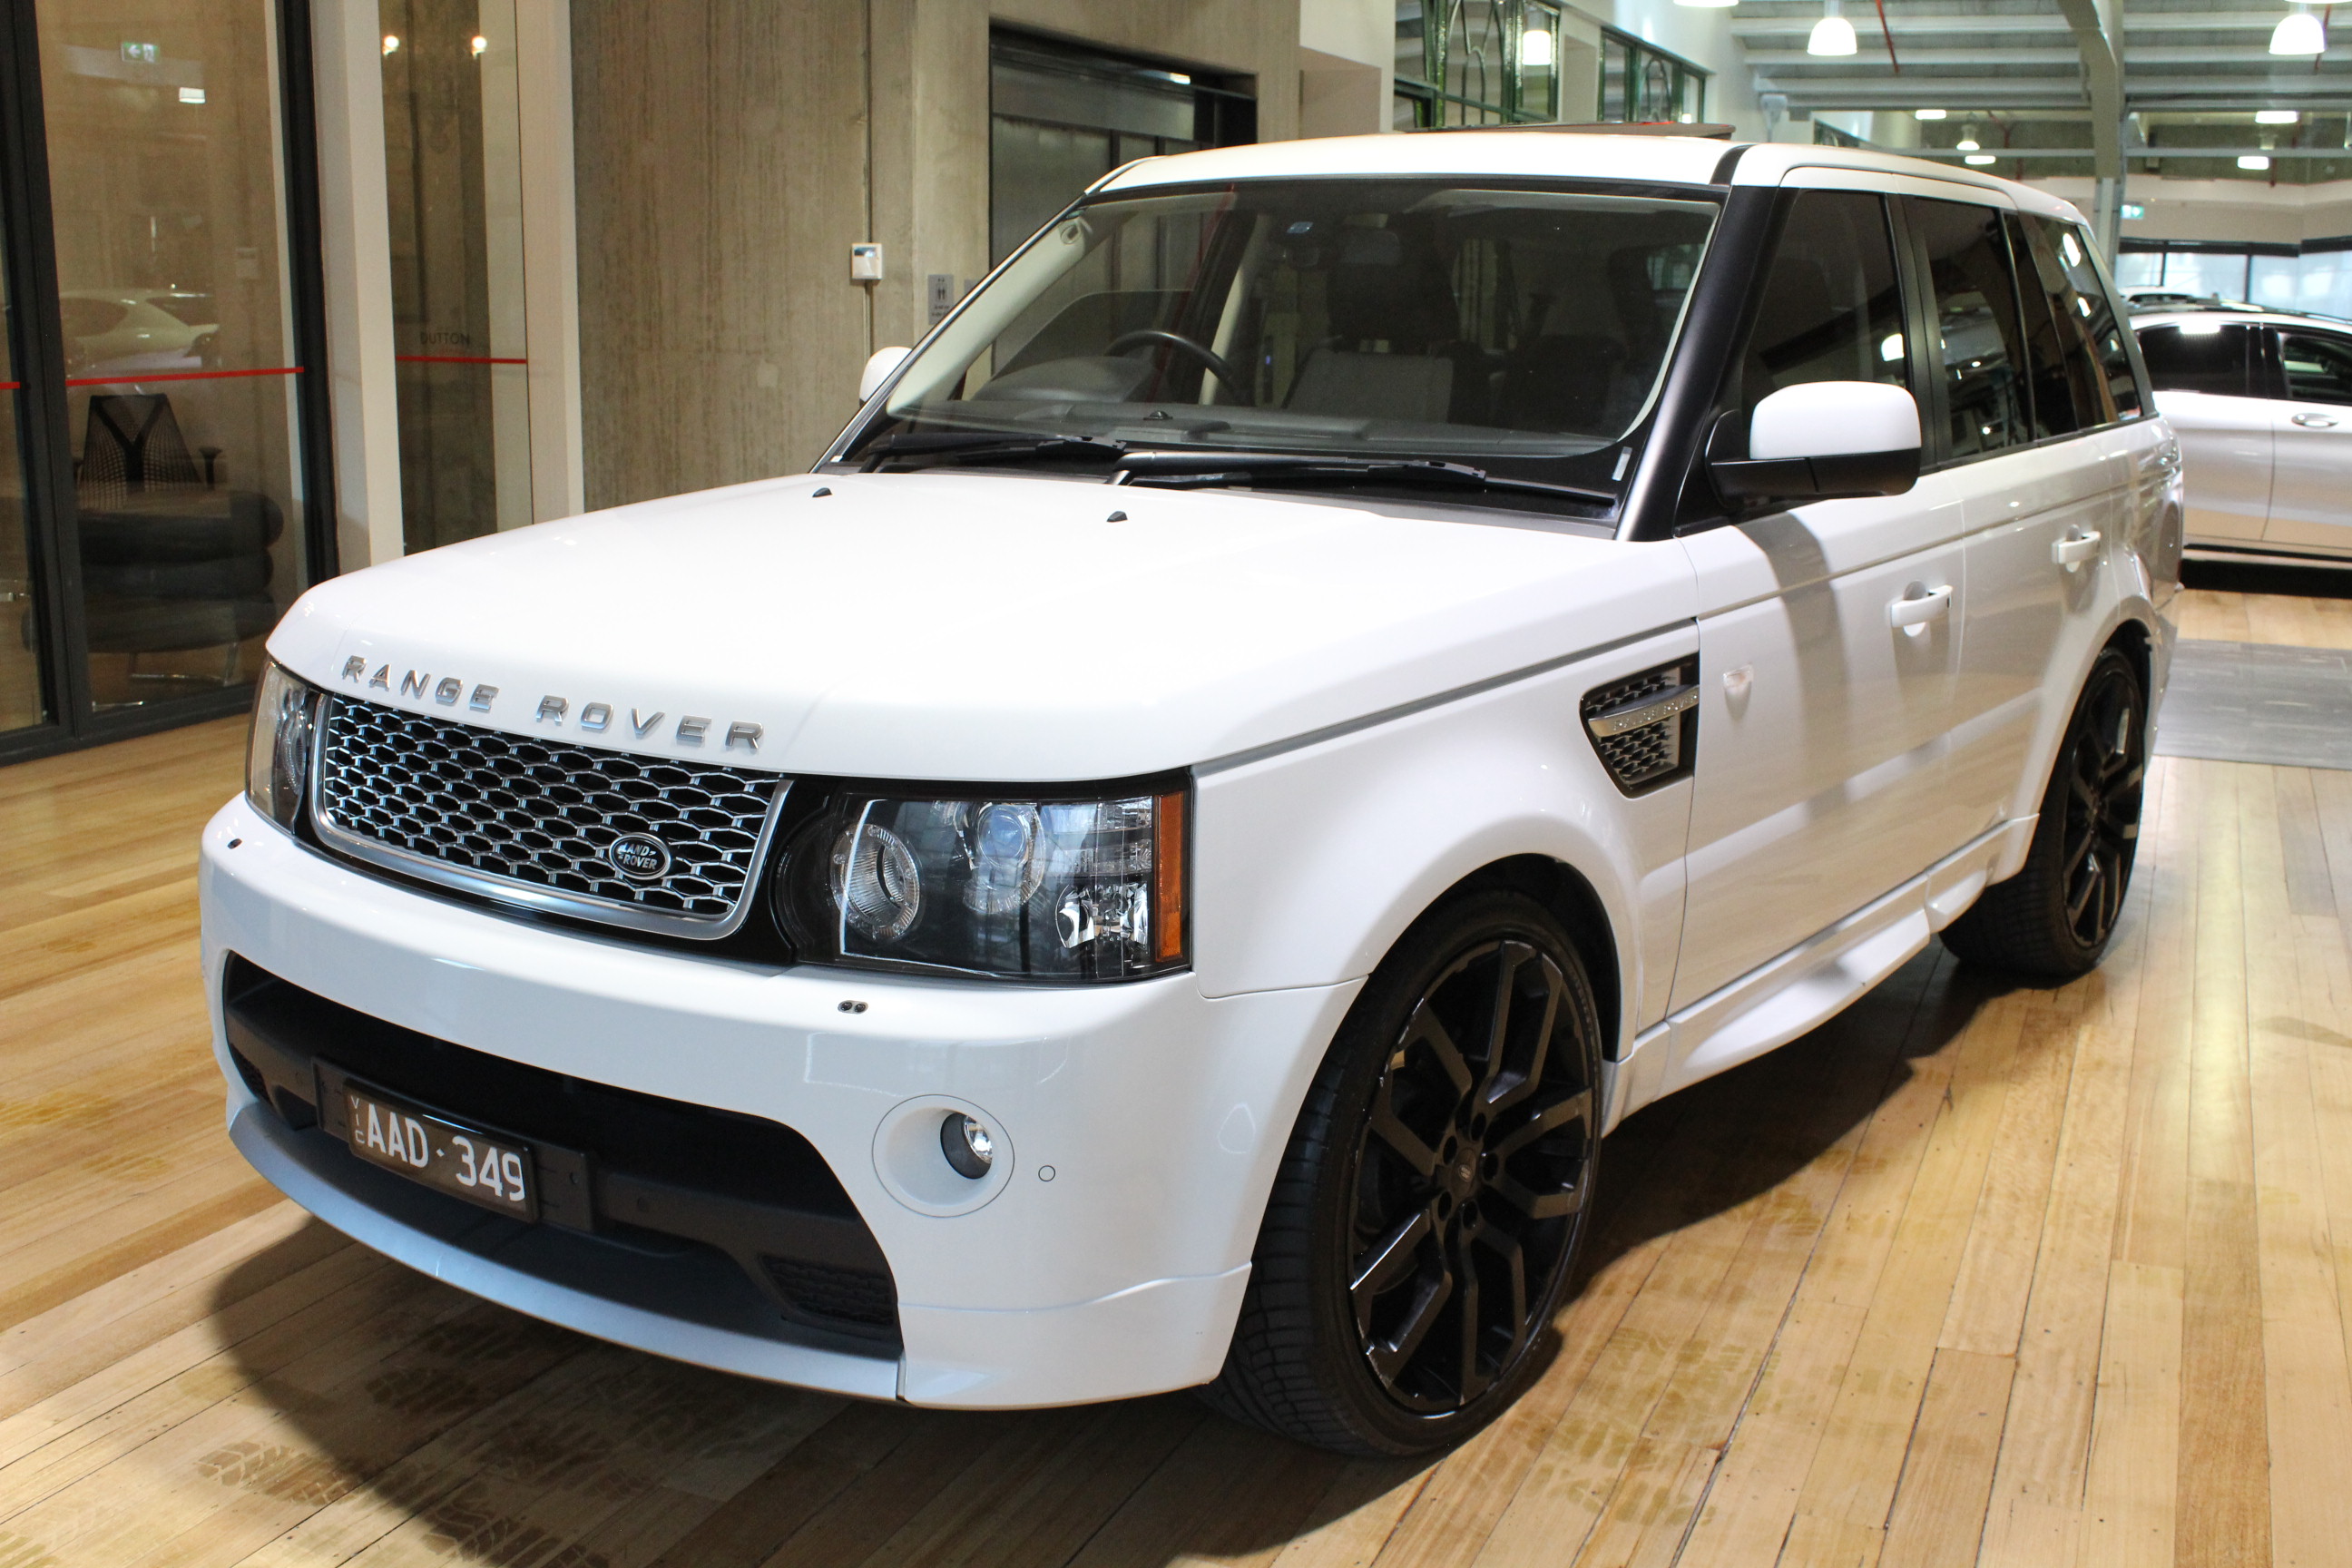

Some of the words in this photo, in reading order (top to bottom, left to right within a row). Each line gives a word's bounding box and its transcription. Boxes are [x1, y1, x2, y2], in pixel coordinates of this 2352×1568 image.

[420, 331, 470, 346] DUTTON
[341, 654, 500, 712] RANGE
[535, 694, 764, 750] ROVER
[617, 842, 650, 857] LAND
[622, 853, 658, 870] ROVER
